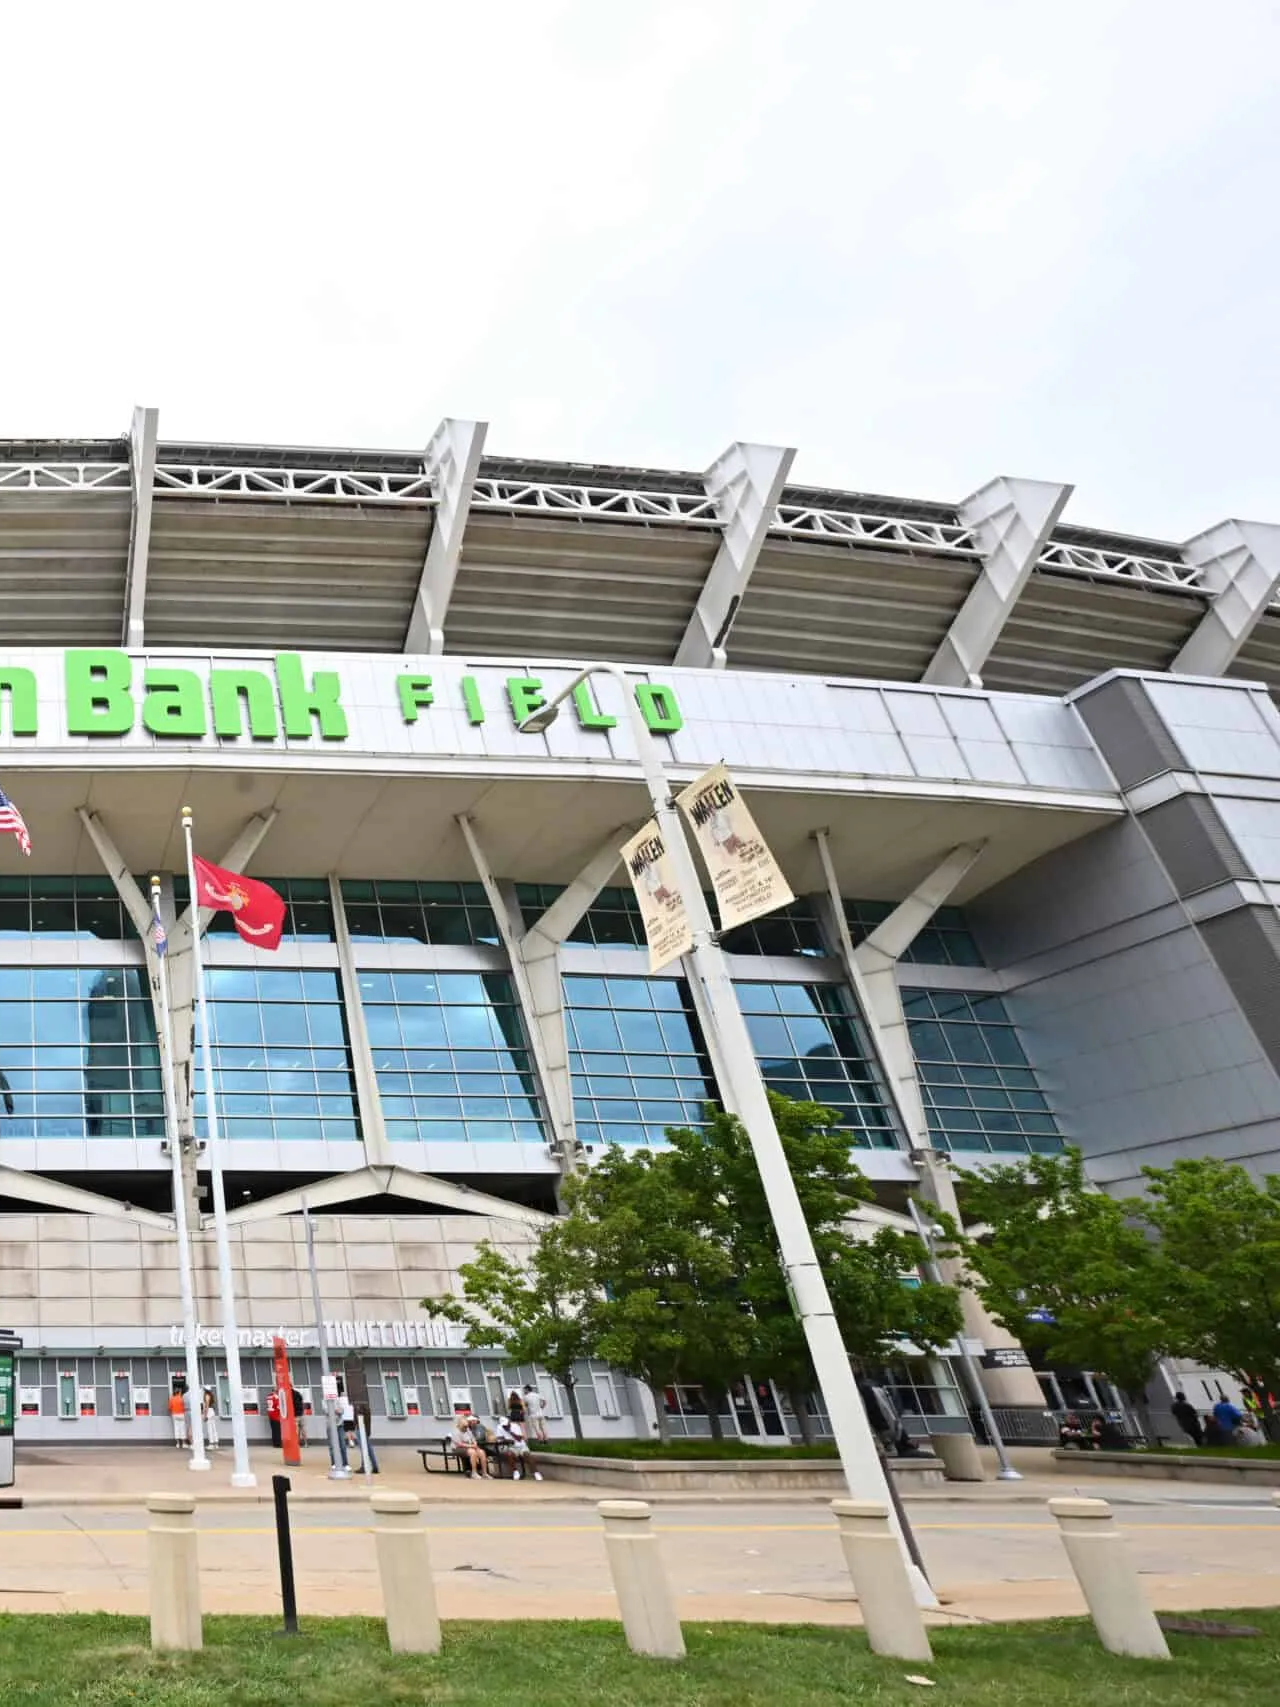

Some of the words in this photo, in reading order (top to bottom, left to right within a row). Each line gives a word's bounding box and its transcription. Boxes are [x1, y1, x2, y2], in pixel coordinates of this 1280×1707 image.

[65, 650, 348, 739] Bank
[396, 674, 683, 732] FIELD
[688, 779, 735, 827] WALLEN
[169, 1323, 310, 1346] tikemaster
[322, 1319, 387, 1346] TICKET
